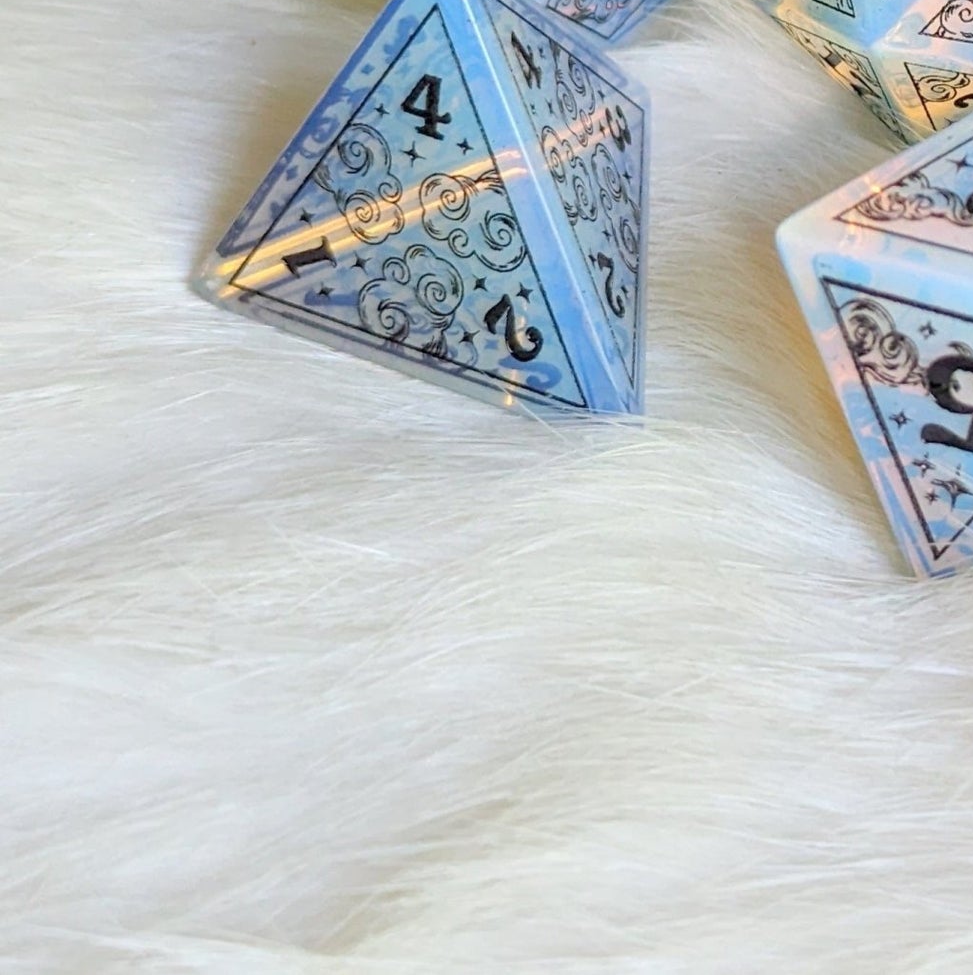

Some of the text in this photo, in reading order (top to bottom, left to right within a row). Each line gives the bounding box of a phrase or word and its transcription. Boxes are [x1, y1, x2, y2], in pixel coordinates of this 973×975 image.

[400, 73, 452, 140] 4
[282, 234, 337, 277] 1
[597, 251, 625, 318] 2
[484, 293, 543, 362] 2
